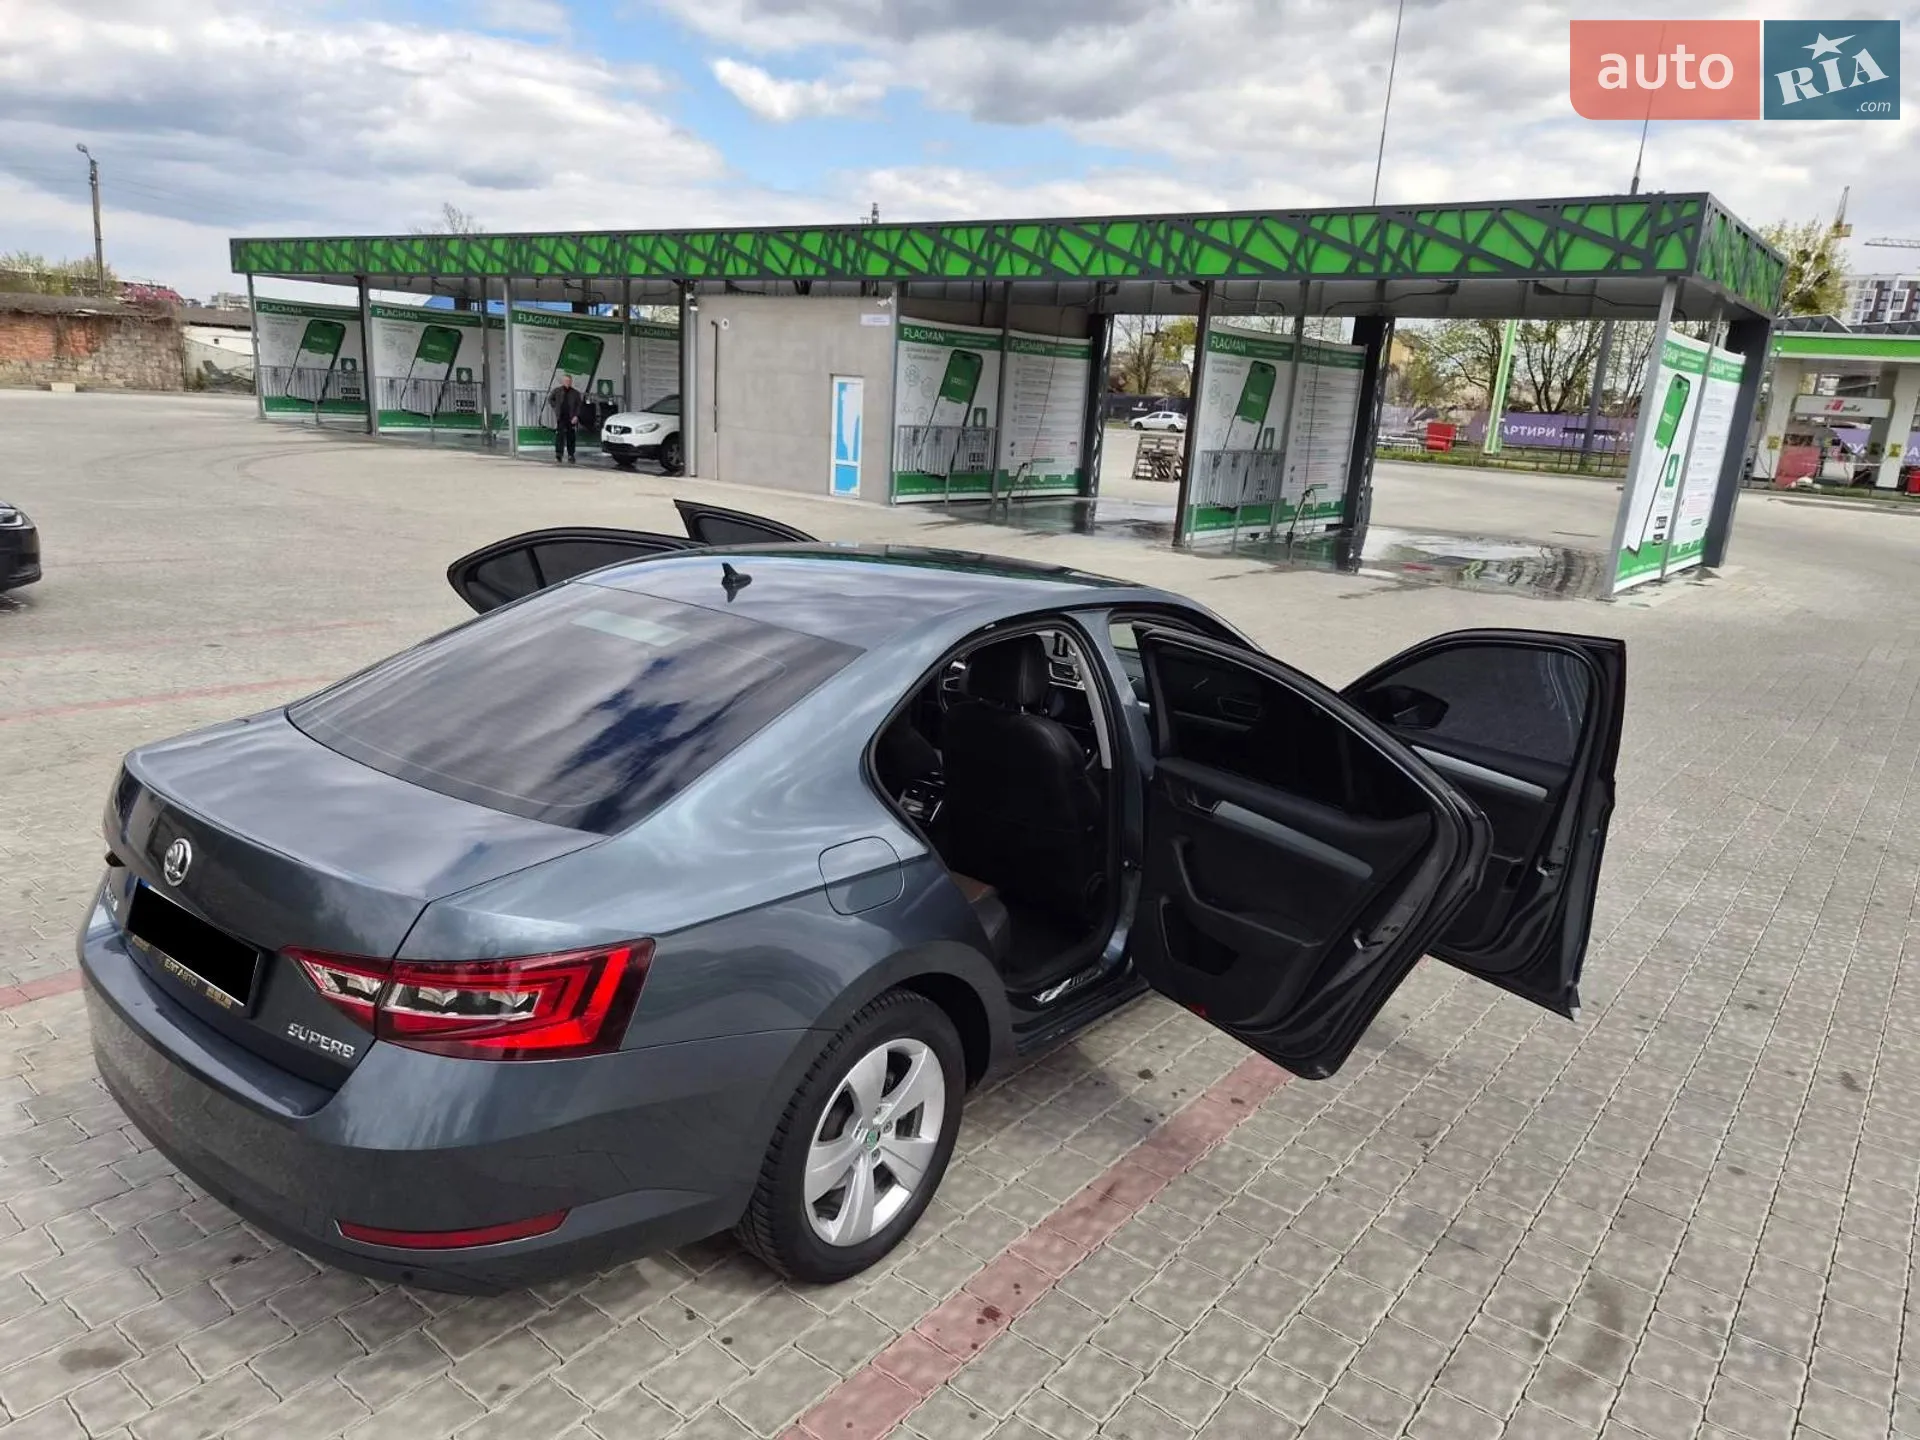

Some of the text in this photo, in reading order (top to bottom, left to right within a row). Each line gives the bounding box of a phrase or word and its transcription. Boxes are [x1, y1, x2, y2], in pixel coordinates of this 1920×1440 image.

[377, 308, 418, 319] FLAGMAN
[518, 312, 559, 327] FLAGMAN
[903, 327, 944, 342] FLAGMAN
[1211, 336, 1246, 352] FLAGMAN
[287, 1022, 356, 1059] SUPERB
